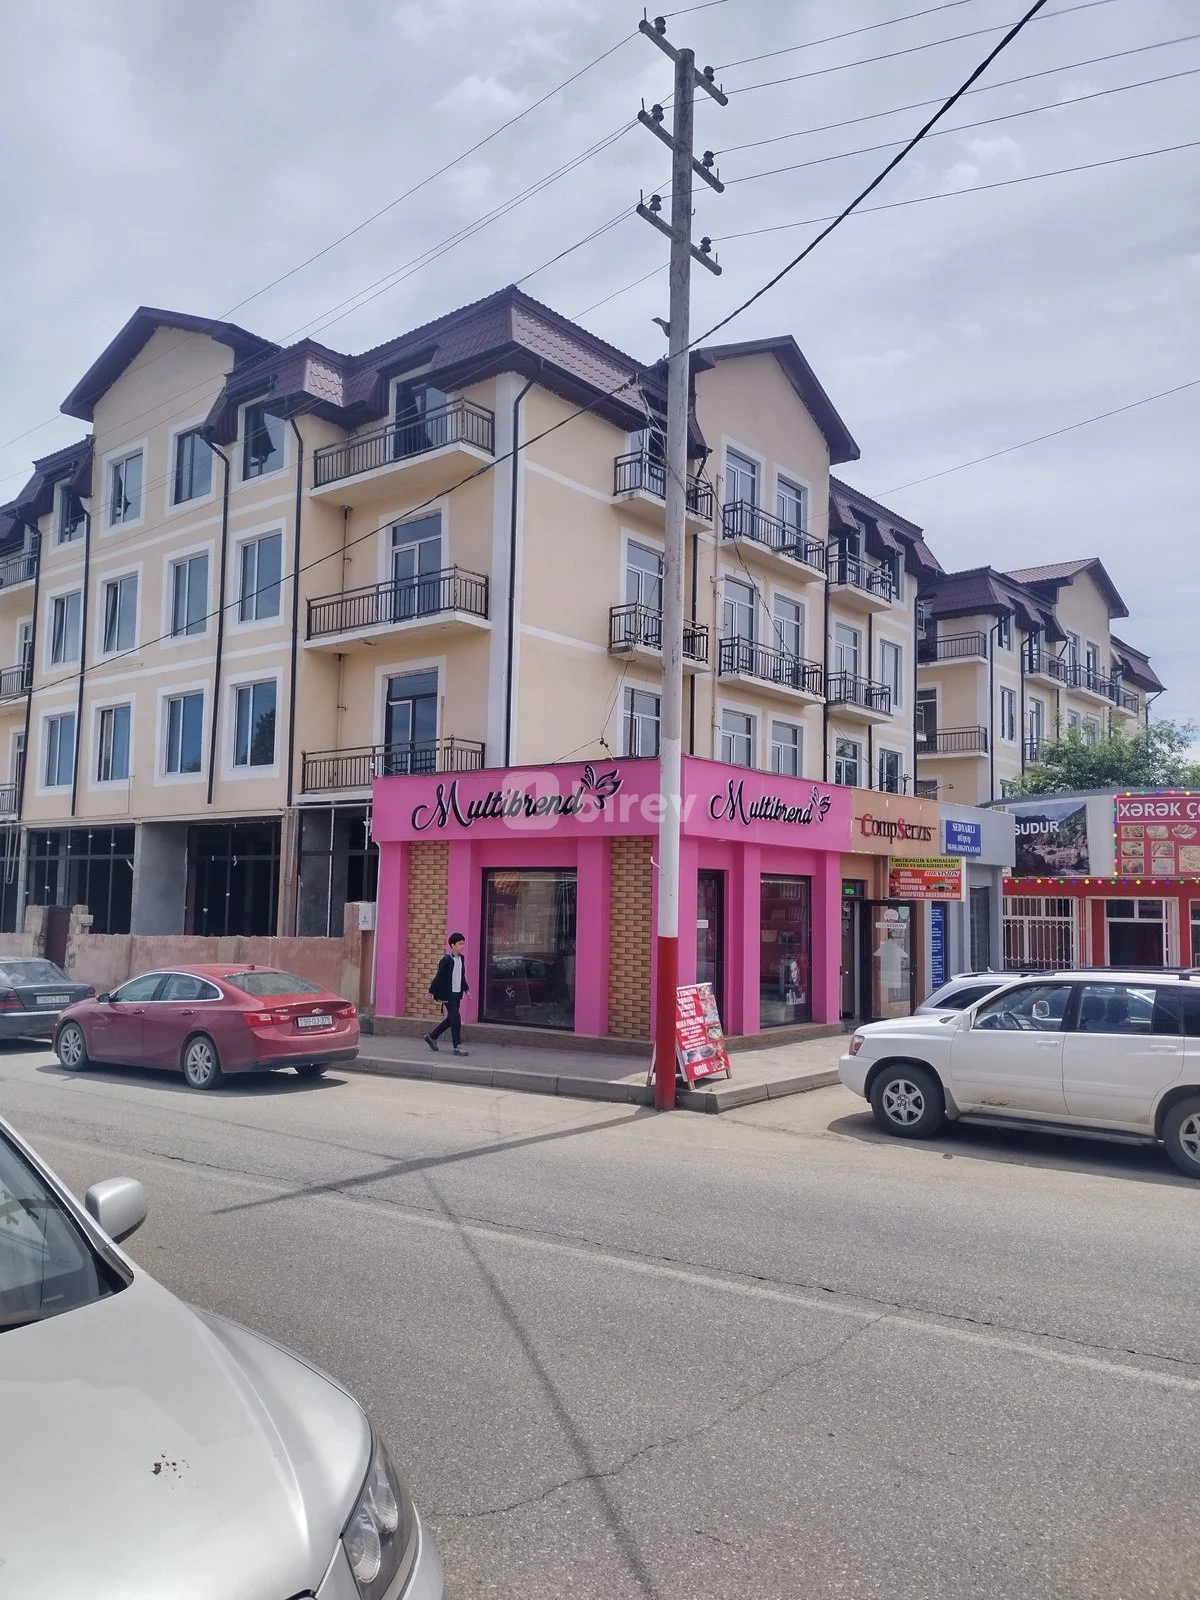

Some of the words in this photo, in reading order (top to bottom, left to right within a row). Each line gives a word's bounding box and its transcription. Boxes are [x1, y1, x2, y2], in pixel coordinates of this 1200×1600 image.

[411, 779, 584, 831] Multibrend
[709, 779, 813, 825] Multibrend
[1119, 803, 1181, 817] XƏRƏK
[1186, 802, 1200, 819] Ç
[855, 813, 936, 844] CompServis
[1015, 821, 1060, 835] SUDUR
